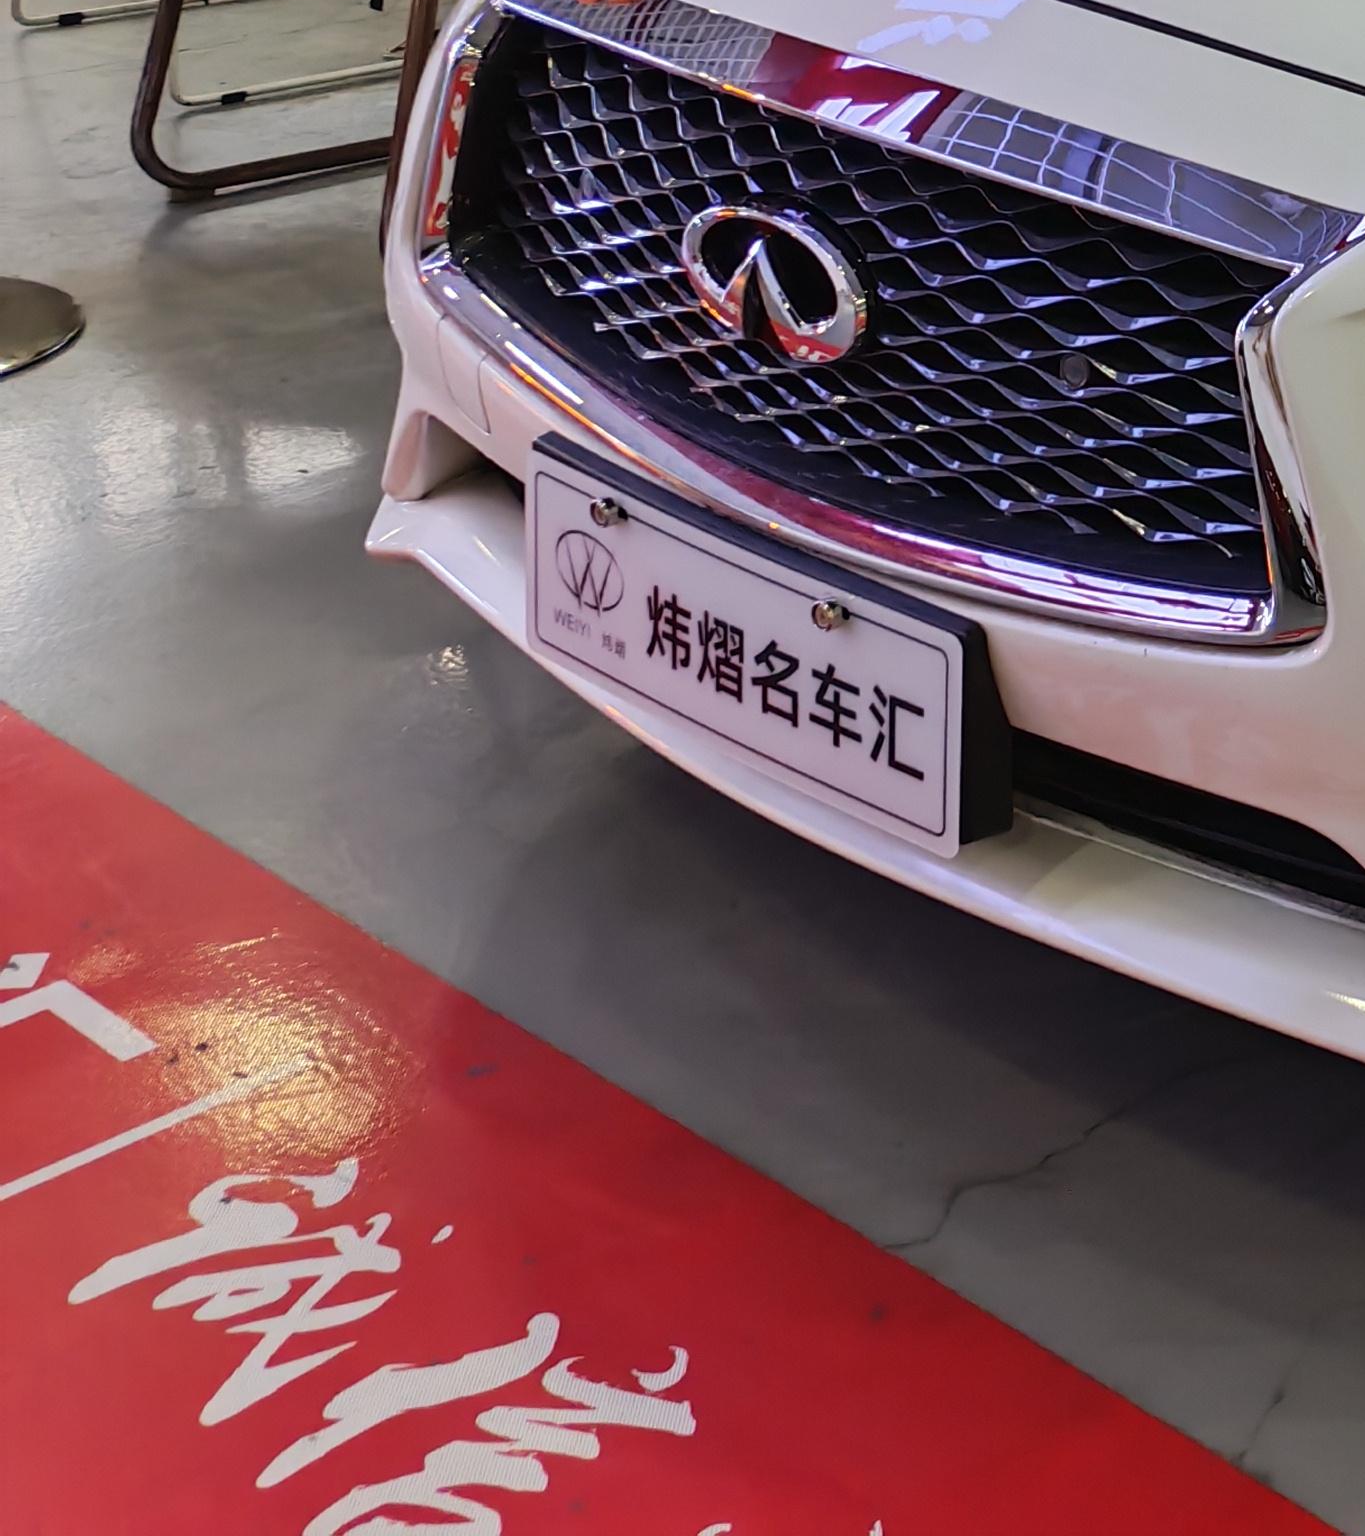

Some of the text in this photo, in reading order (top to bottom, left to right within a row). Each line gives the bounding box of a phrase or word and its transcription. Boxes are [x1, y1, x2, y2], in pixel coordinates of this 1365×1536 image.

[646, 584, 925, 782] 炜熠名车汇
